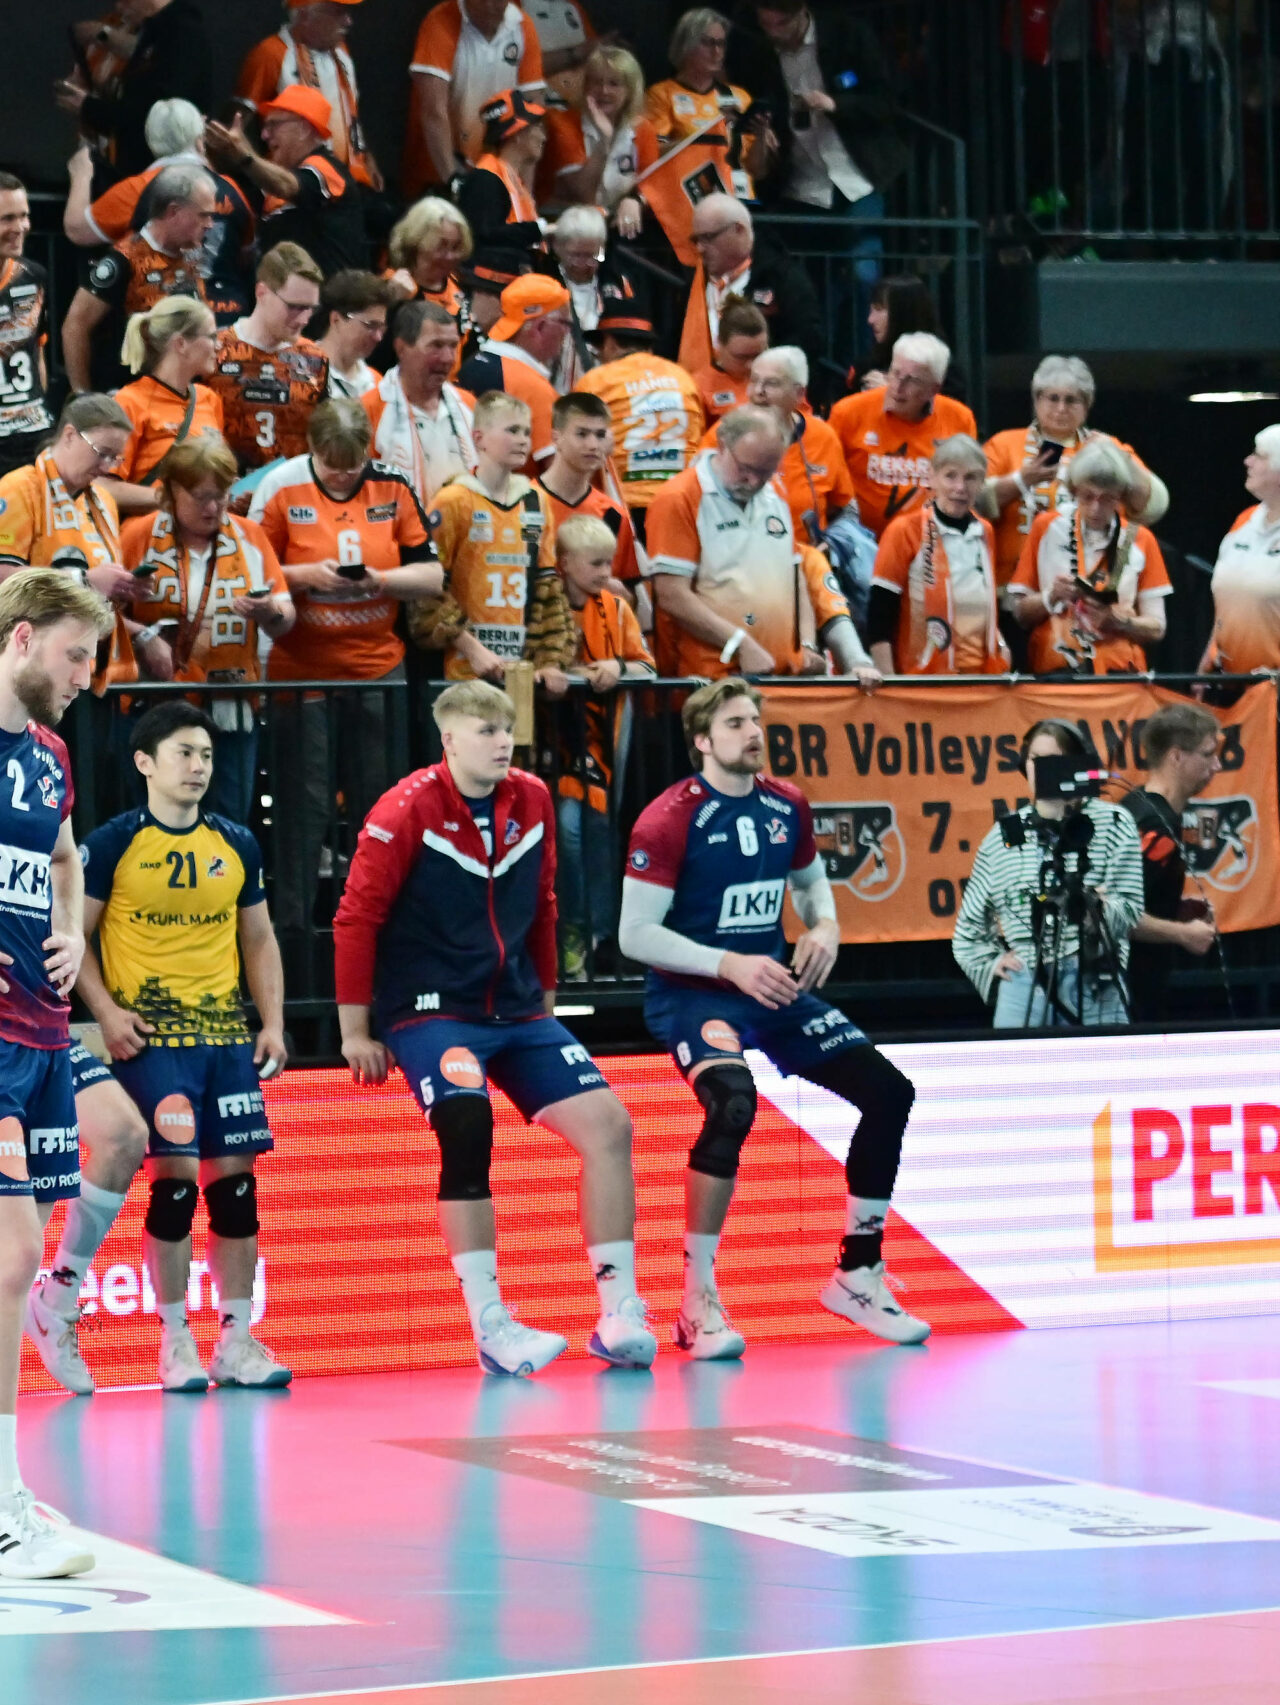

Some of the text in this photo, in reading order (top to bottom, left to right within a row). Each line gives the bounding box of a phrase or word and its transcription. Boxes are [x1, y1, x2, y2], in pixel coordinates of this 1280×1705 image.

[255, 411, 276, 448] 3
[622, 411, 688, 449] 22
[337, 529, 361, 566] 6
[484, 572, 528, 608] 13
[766, 723, 829, 777] BR
[845, 722, 1020, 785] Volleys
[6, 758, 30, 812] 2
[736, 815, 759, 856] 6
[166, 851, 197, 889] 21
[728, 889, 780, 918] LKH
[414, 992, 441, 1011] JM
[676, 1040, 692, 1067] 6
[223, 1132, 249, 1146] ROY
[30, 1176, 57, 1189] ROY
